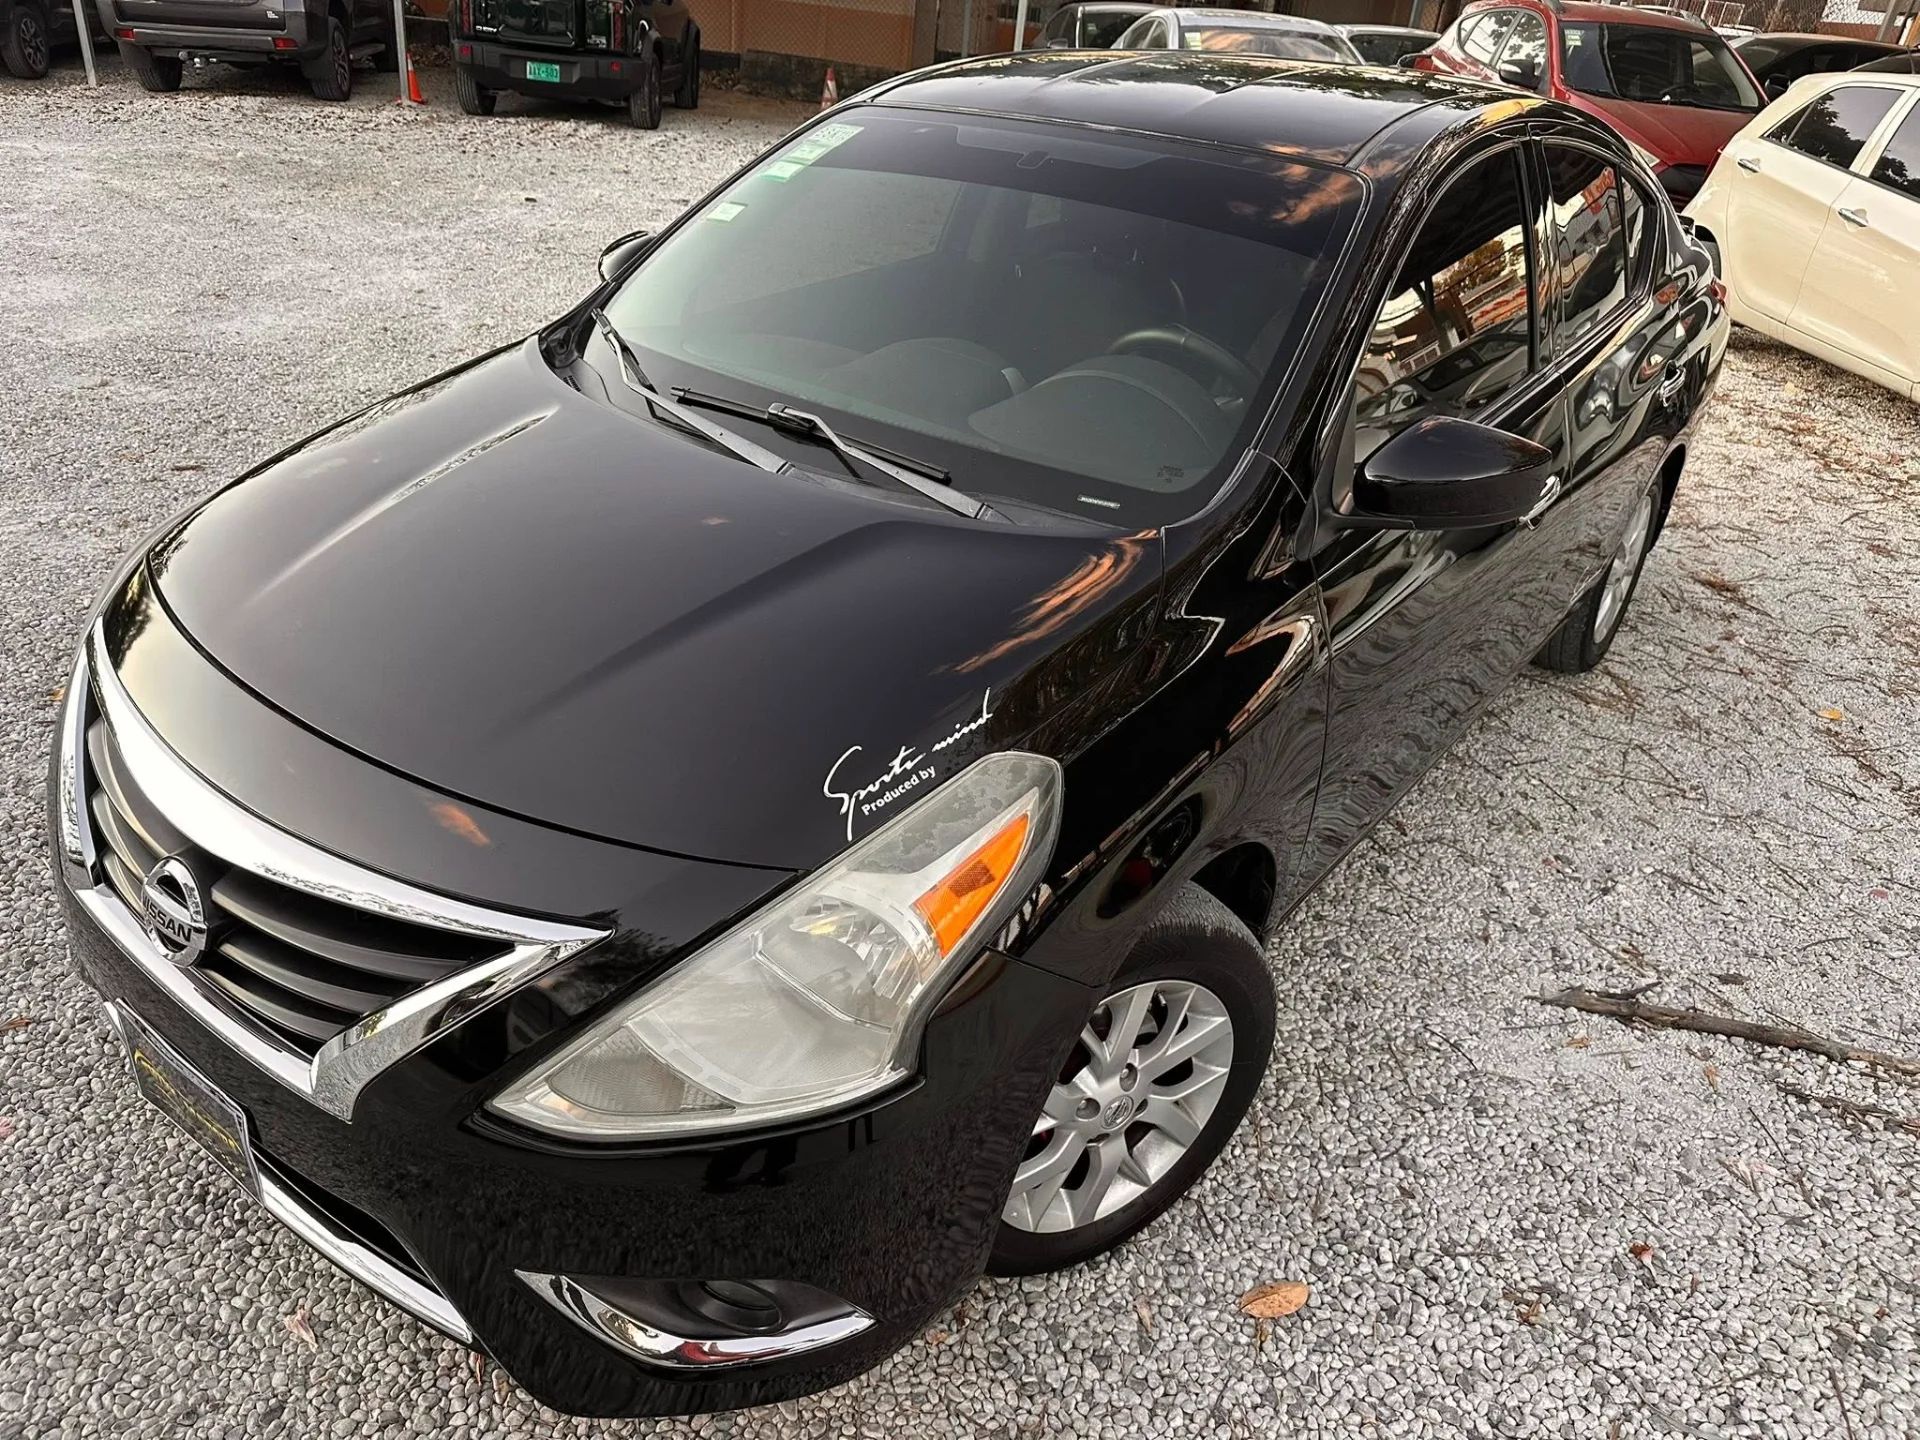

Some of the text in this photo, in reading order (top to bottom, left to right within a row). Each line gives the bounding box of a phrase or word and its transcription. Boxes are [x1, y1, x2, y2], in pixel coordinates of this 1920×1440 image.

[861, 765, 936, 816] Produced by
[142, 894, 193, 943] NISSAN
